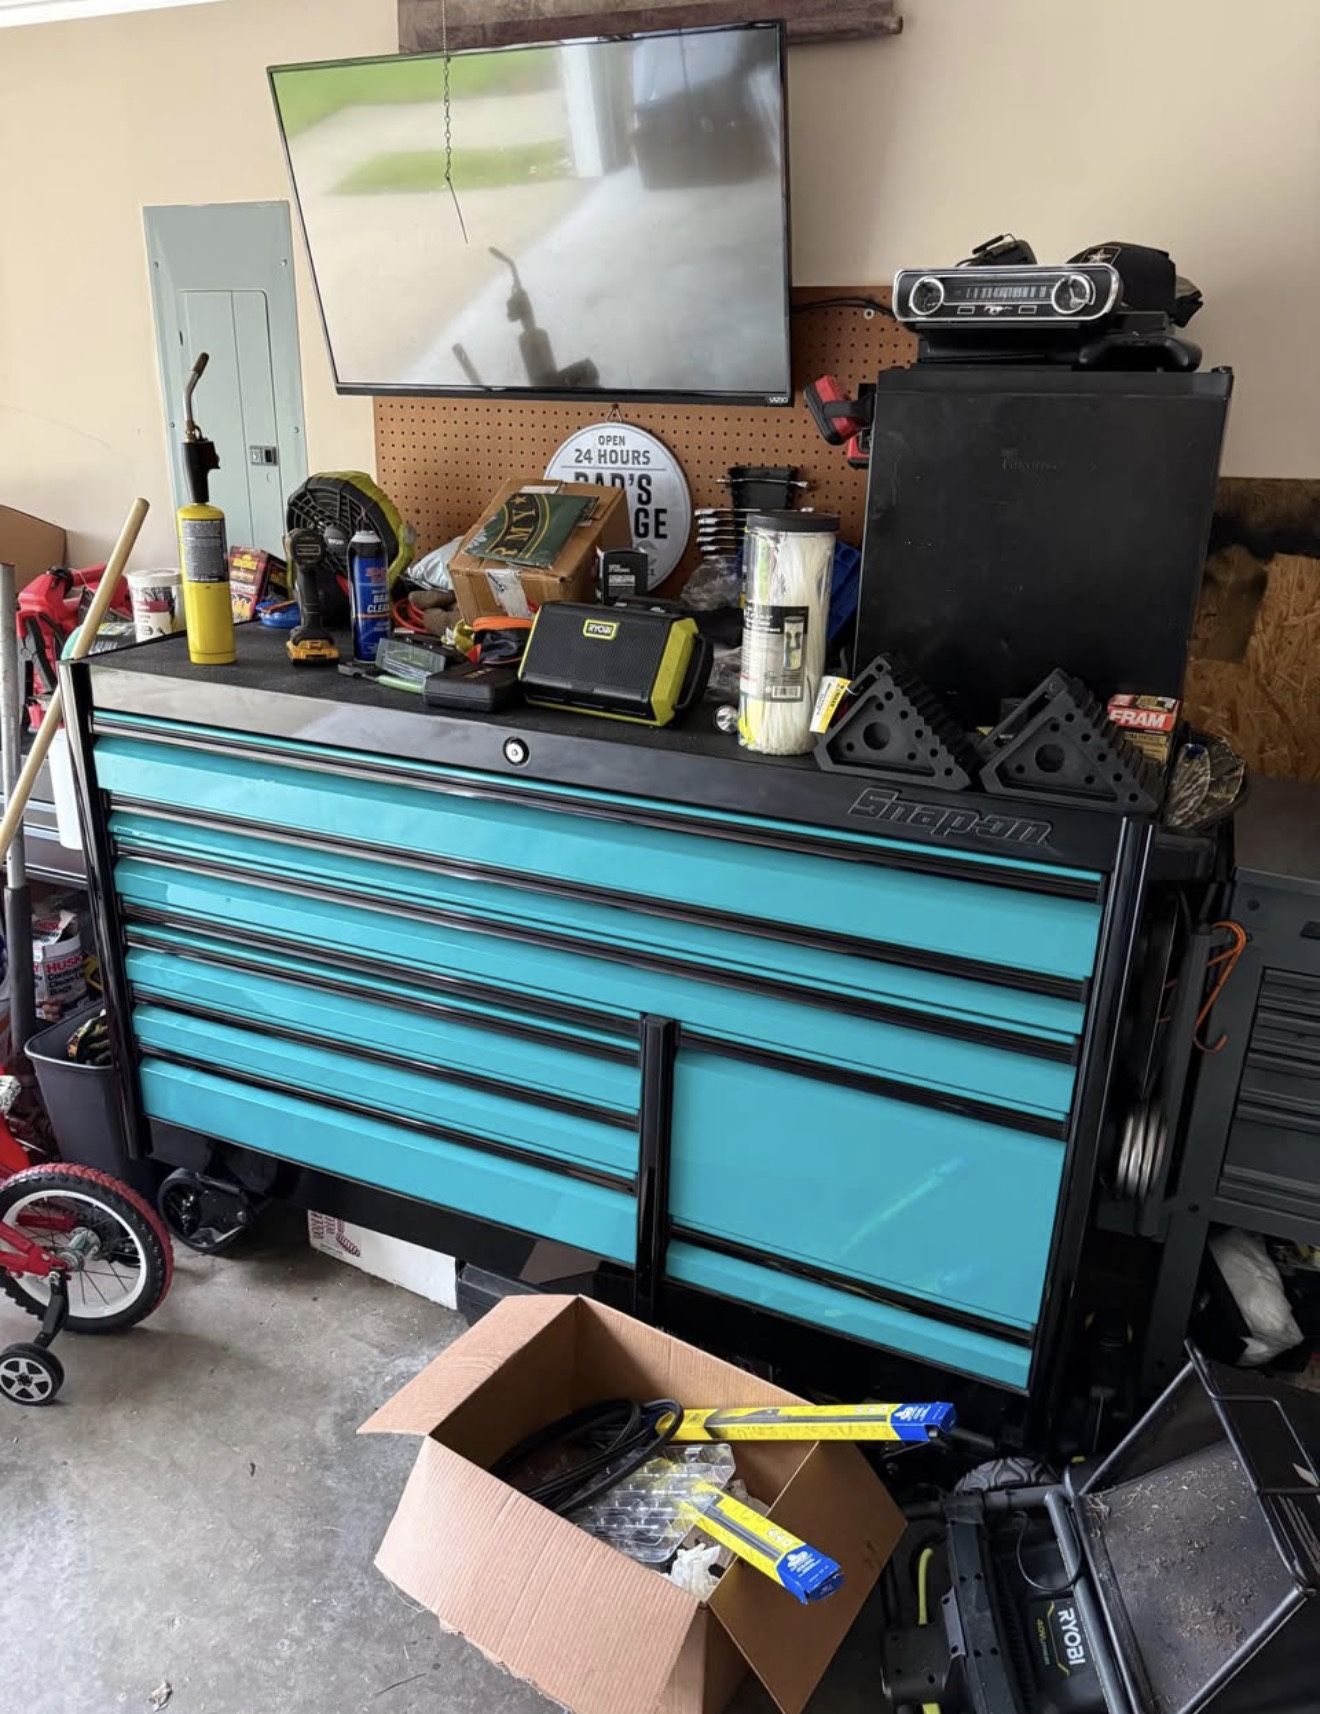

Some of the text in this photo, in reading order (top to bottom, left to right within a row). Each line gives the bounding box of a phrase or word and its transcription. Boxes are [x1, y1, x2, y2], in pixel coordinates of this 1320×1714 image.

[598, 435, 626, 446] OPEN
[574, 449, 651, 465] 24 HOURS
[1109, 710, 1167, 729] FRAM
[1058, 1607, 1086, 1665] RYOBI
